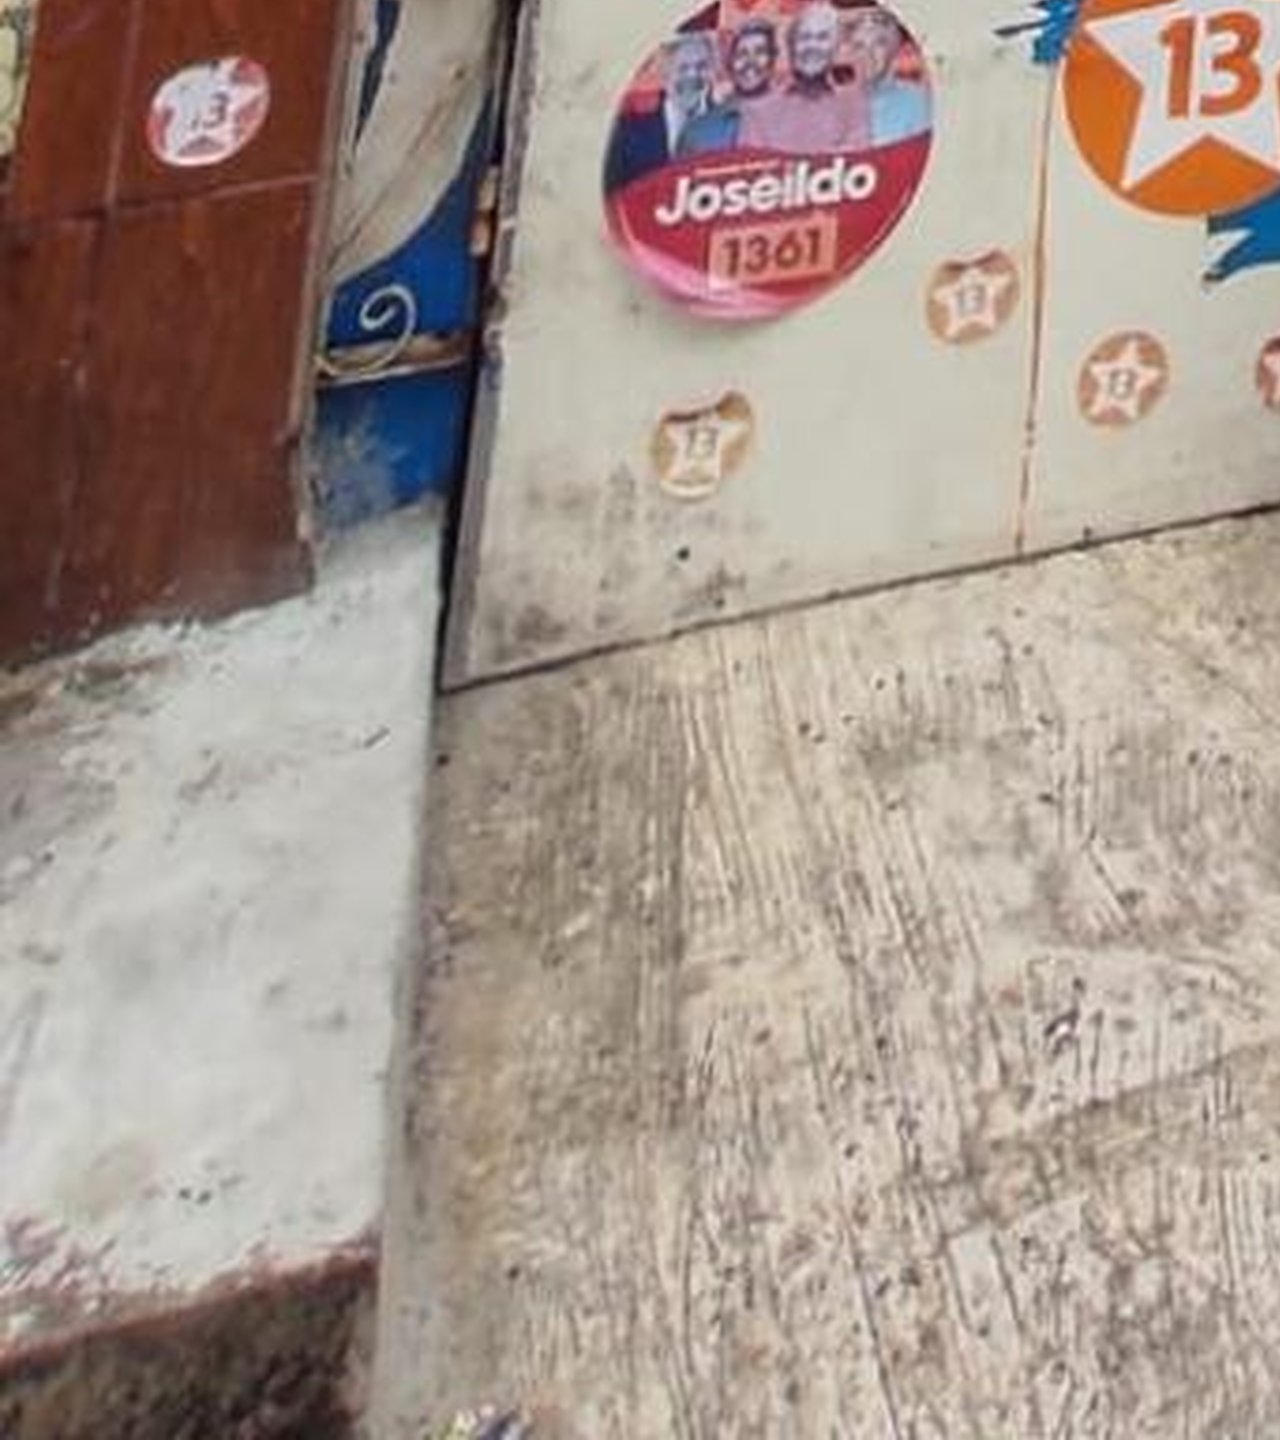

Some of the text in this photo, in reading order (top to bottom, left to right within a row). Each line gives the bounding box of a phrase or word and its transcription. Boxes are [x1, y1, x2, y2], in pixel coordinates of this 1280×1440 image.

[1160, 10, 1263, 119] 13
[655, 157, 877, 226] Joseildo
[721, 228, 822, 277] 1361
[954, 285, 987, 315] 13
[1107, 368, 1136, 400] 13
